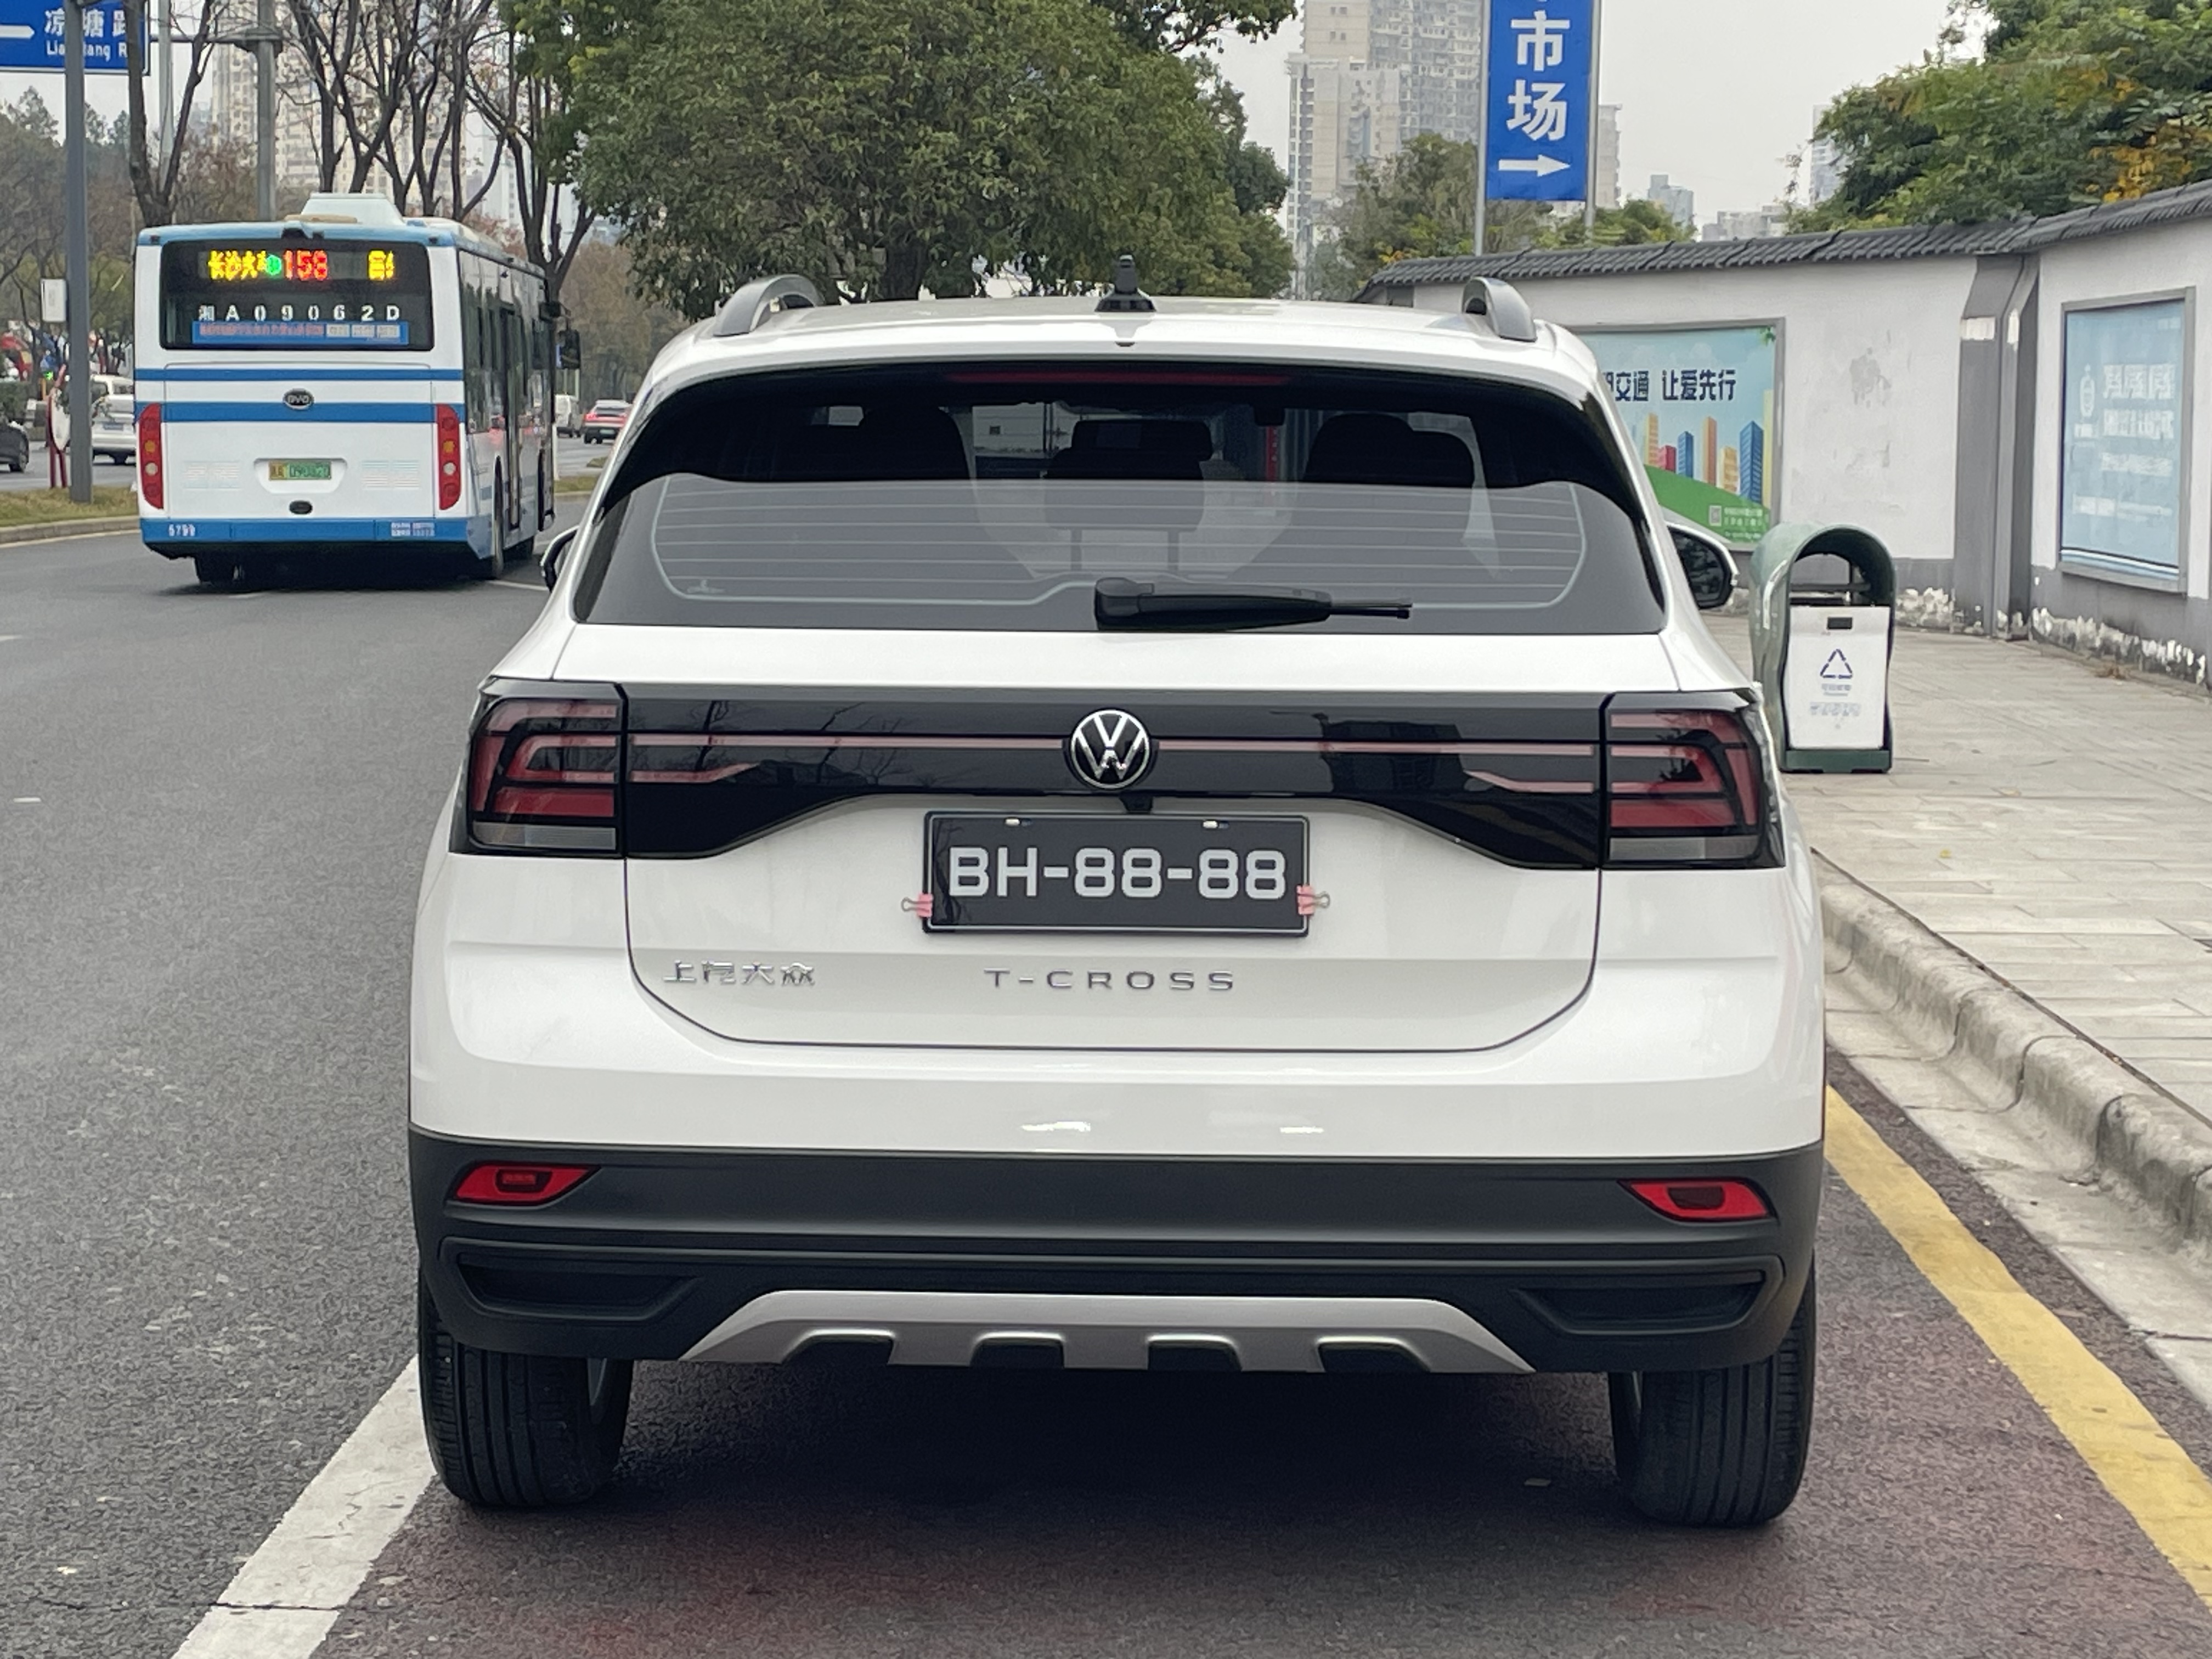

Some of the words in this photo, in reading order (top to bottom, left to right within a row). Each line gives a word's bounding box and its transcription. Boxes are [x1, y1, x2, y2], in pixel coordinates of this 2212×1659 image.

[46, 40, 111, 61] Liaang
[1506, 10, 1570, 141] 市场
[1662, 369, 1736, 402] 让爱先行
[949, 847, 1286, 900] BH-88-88
[662, 960, 816, 985] 上汽大众
[984, 968, 1233, 990] T-CROSS
